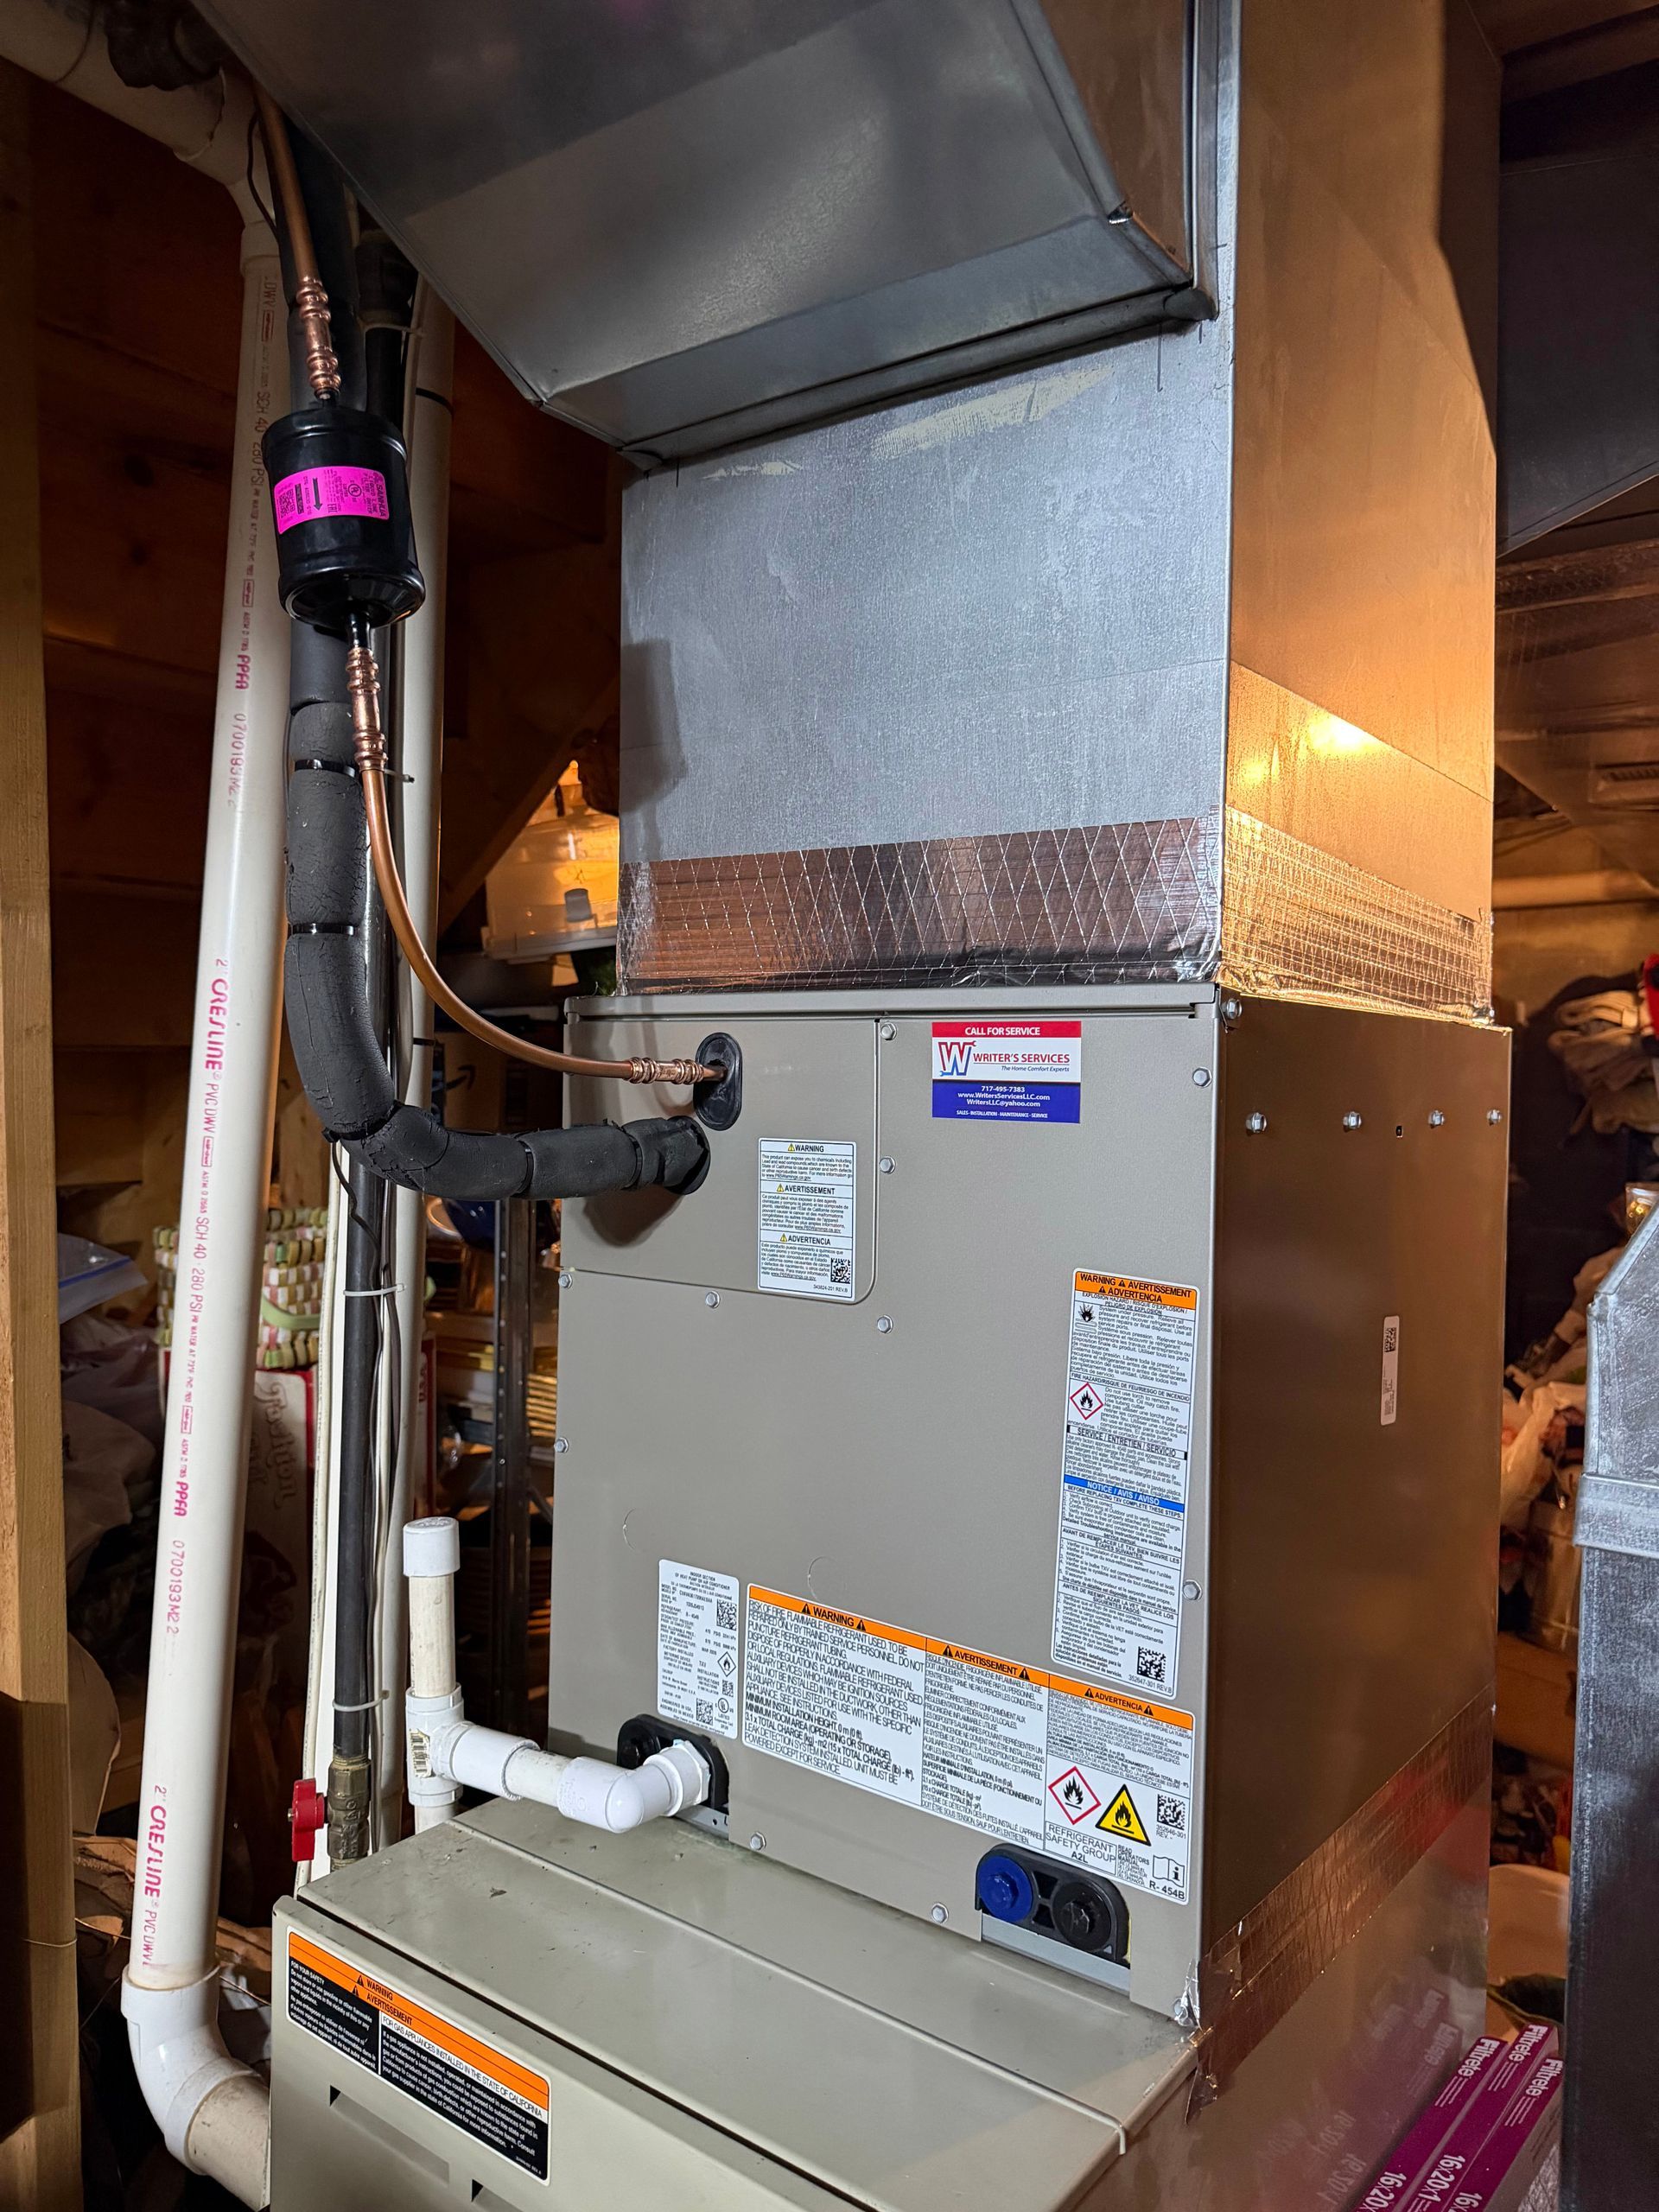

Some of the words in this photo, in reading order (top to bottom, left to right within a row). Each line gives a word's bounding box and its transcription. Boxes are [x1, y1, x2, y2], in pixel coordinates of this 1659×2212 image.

[256, 391, 270, 413] SCH
[255, 417, 267, 432] 40
[251, 468, 264, 486] PSI
[235, 654, 251, 690] PPFA
[973, 1053, 1019, 1062] WRITER'S
[1021, 1053, 1070, 1062] SERVICES
[205, 1083, 219, 1104] PVC
[957, 1091, 1050, 1100] www.WritersServicesLLC.com
[967, 1098, 1039, 1107] WritersLLC@yahoo.com
[204, 1108, 218, 1133] DWV
[785, 1185, 835, 1194] AVERTISSEMENT
[195, 1217, 209, 1240] SCH
[788, 1235, 830, 1245] ADVERTENCIA
[194, 1243, 207, 1260] 40
[191, 1268, 205, 1291] 280
[1080, 1273, 1116, 1285] WARNING
[1128, 1281, 1191, 1298] AVERTISSEMENT
[189, 1294, 203, 1313] PSI
[1108, 1287, 1162, 1302] ADVERTENCIA
[189, 1326, 198, 1346] WATER
[1166, 1392, 1189, 1402] INCENDIO
[1077, 1427, 1103, 1440] SERVICE
[1109, 1434, 1141, 1449] ENTRETIEN
[1146, 1443, 1176, 1457] SERVICIO
[175, 1481, 189, 1517] PPFA
[1067, 1484, 1085, 1493] BEFORE
[1086, 1489, 1111, 1500] REPLACING
[1122, 1498, 1147, 1510] COMPLETE
[1149, 1505, 1164, 1514] THESE
[1087, 1481, 1112, 1494] NOTICE
[1117, 1489, 1133, 1499] AVIS
[1138, 1494, 1160, 1505] AVISO
[813, 1605, 854, 1627] WARNING
[748, 1620, 779, 1638] PUNCTURE
[780, 1630, 823, 1652] REFRIGERANT
[762, 1603, 771, 1615] OF
[786, 1610, 822, 1630] FLAMMABLE
[823, 1621, 867, 1643] REFRIGERANT
[887, 1641, 898, 1653] TO
[898, 1643, 907, 1656] BE
[747, 1630, 772, 1647] DISPOSE
[773, 1637, 782, 1649] OF
[782, 1641, 815, 1660] PROPERLY
[815, 1650, 821, 1662] IN
[821, 1653, 866, 1676] ACCORDANCE
[866, 1667, 883, 1681] WITH
[777, 1618, 793, 1632] ONLY
[793, 1623, 803, 1635] BY
[803, 1625, 829, 1643] TRAINED
[829, 1634, 855, 1651] SERVICE
[899, 1655, 909, 1669] DO
[909, 1658, 924, 1673] NOT
[954, 1649, 1017, 1675] AVERTISSEMENT
[1095, 1691, 1142, 1712] ADVERTENCIA
[1046, 1832, 1084, 1853] SAFETY
[1085, 1846, 1115, 1864] GROUP
[1048, 1823, 1112, 1853] REFRIGERANT
[1071, 1850, 1088, 1863] A2L
[1161, 1885, 1185, 1900] 454B
[143, 1910, 157, 1933] PVC
[143, 1936, 154, 1960] DWV
[366, 1978, 392, 2001] WARNING
[366, 1992, 412, 2026] AVERTISSEMENT
[1508, 2024, 1548, 2062] Filtrete
[383, 2015, 393, 2028] FOR
[394, 2022, 404, 2035] GAS
[404, 2029, 435, 2054] APPLIANCES
[435, 2047, 463, 2071] INSTALLED
[464, 2064, 470, 2075] IN
[471, 2068, 481, 2082] THE
[482, 2075, 499, 2093] STATE
[500, 2086, 508, 2098] OF
[508, 2091, 542, 2119] CALIFORNIA
[1458, 2038, 1500, 2076] Filtrete
[1525, 2058, 1563, 2096] Filtrete
[1418, 2154, 1465, 2202] 16x20x1
